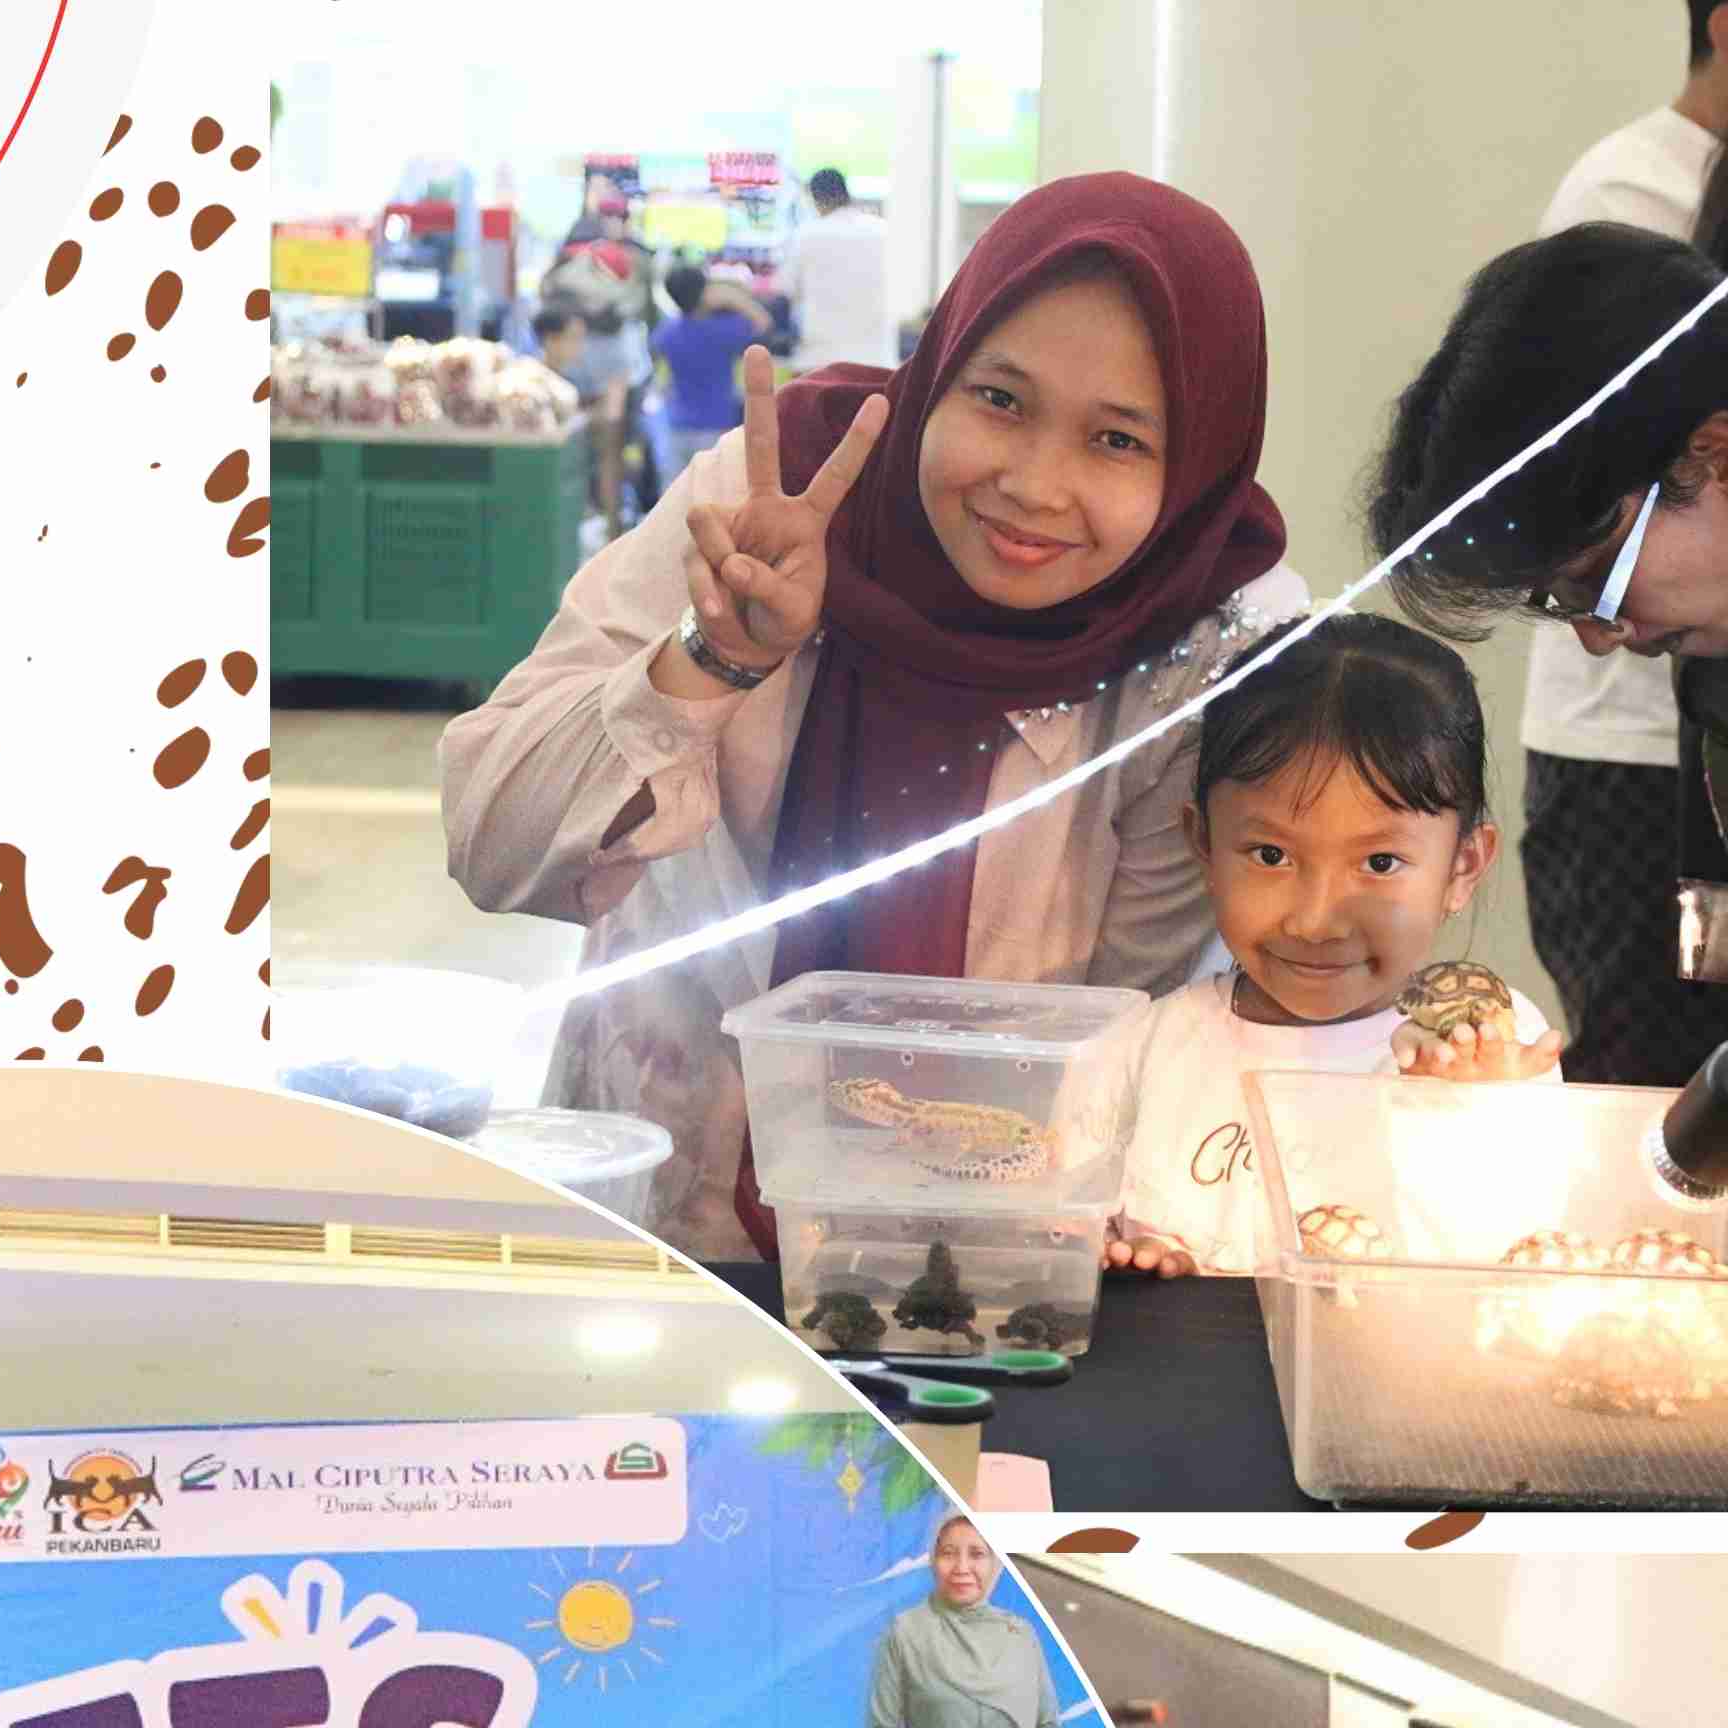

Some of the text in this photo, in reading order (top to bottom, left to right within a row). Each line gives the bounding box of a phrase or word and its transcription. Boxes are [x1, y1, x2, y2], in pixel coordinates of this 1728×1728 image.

[232, 1460, 595, 1491] MAL CIPUTRA SERAYA
[46, 1507, 160, 1535] ICA
[45, 1537, 161, 1554] PEKANBARU
